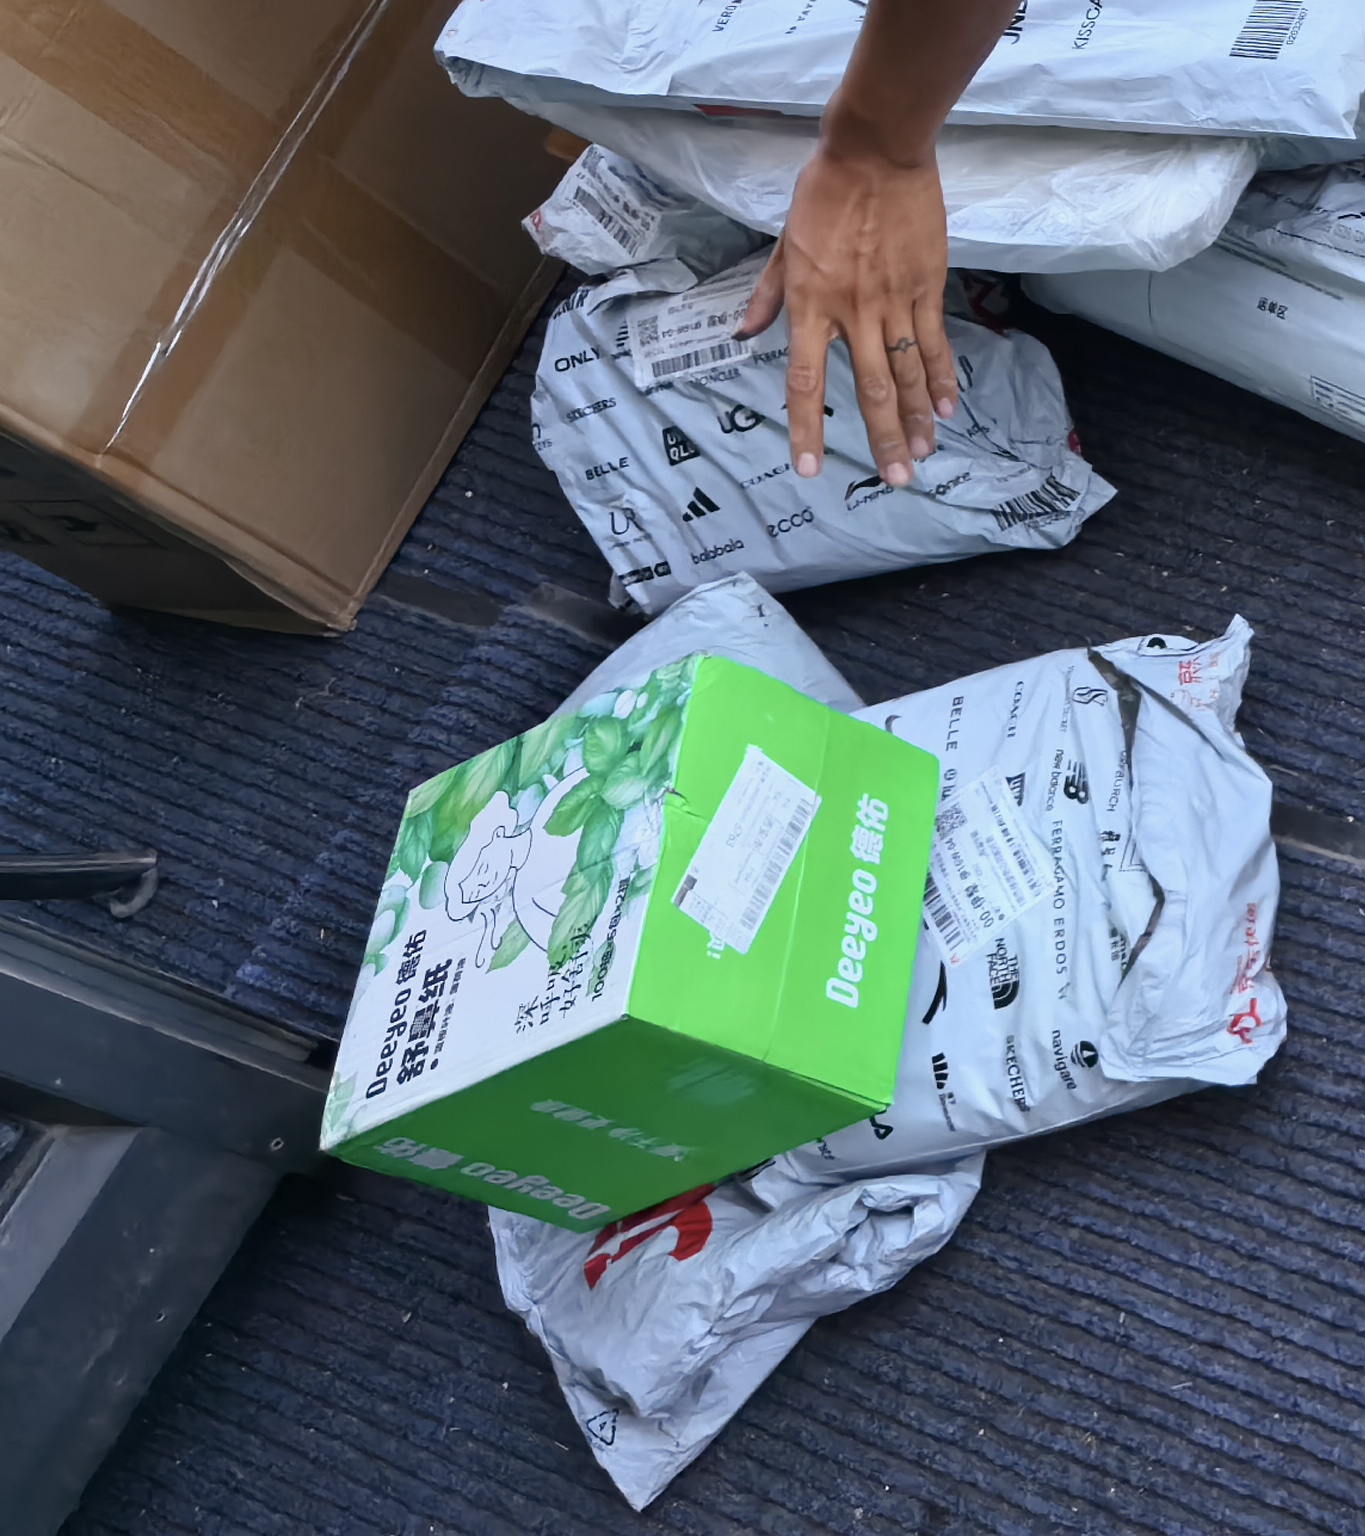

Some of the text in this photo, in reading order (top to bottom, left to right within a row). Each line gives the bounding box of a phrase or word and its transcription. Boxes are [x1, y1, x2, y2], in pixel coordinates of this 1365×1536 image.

[554, 346, 601, 373] ONLY
[585, 457, 629, 483] BELLE
[691, 538, 745, 566] balabala
[944, 694, 965, 752] BELLE
[1052, 819, 1066, 911] FERRAGAMO
[825, 792, 891, 1010] Deeyeo 德佑
[1052, 916, 1068, 976] ERDOS
[364, 924, 429, 1103] Deeyeo 德佑
[1005, 1034, 1031, 1114] SKECHERS
[1051, 1028, 1078, 1092] navigare
[459, 1147, 613, 1227] Deeyeo
